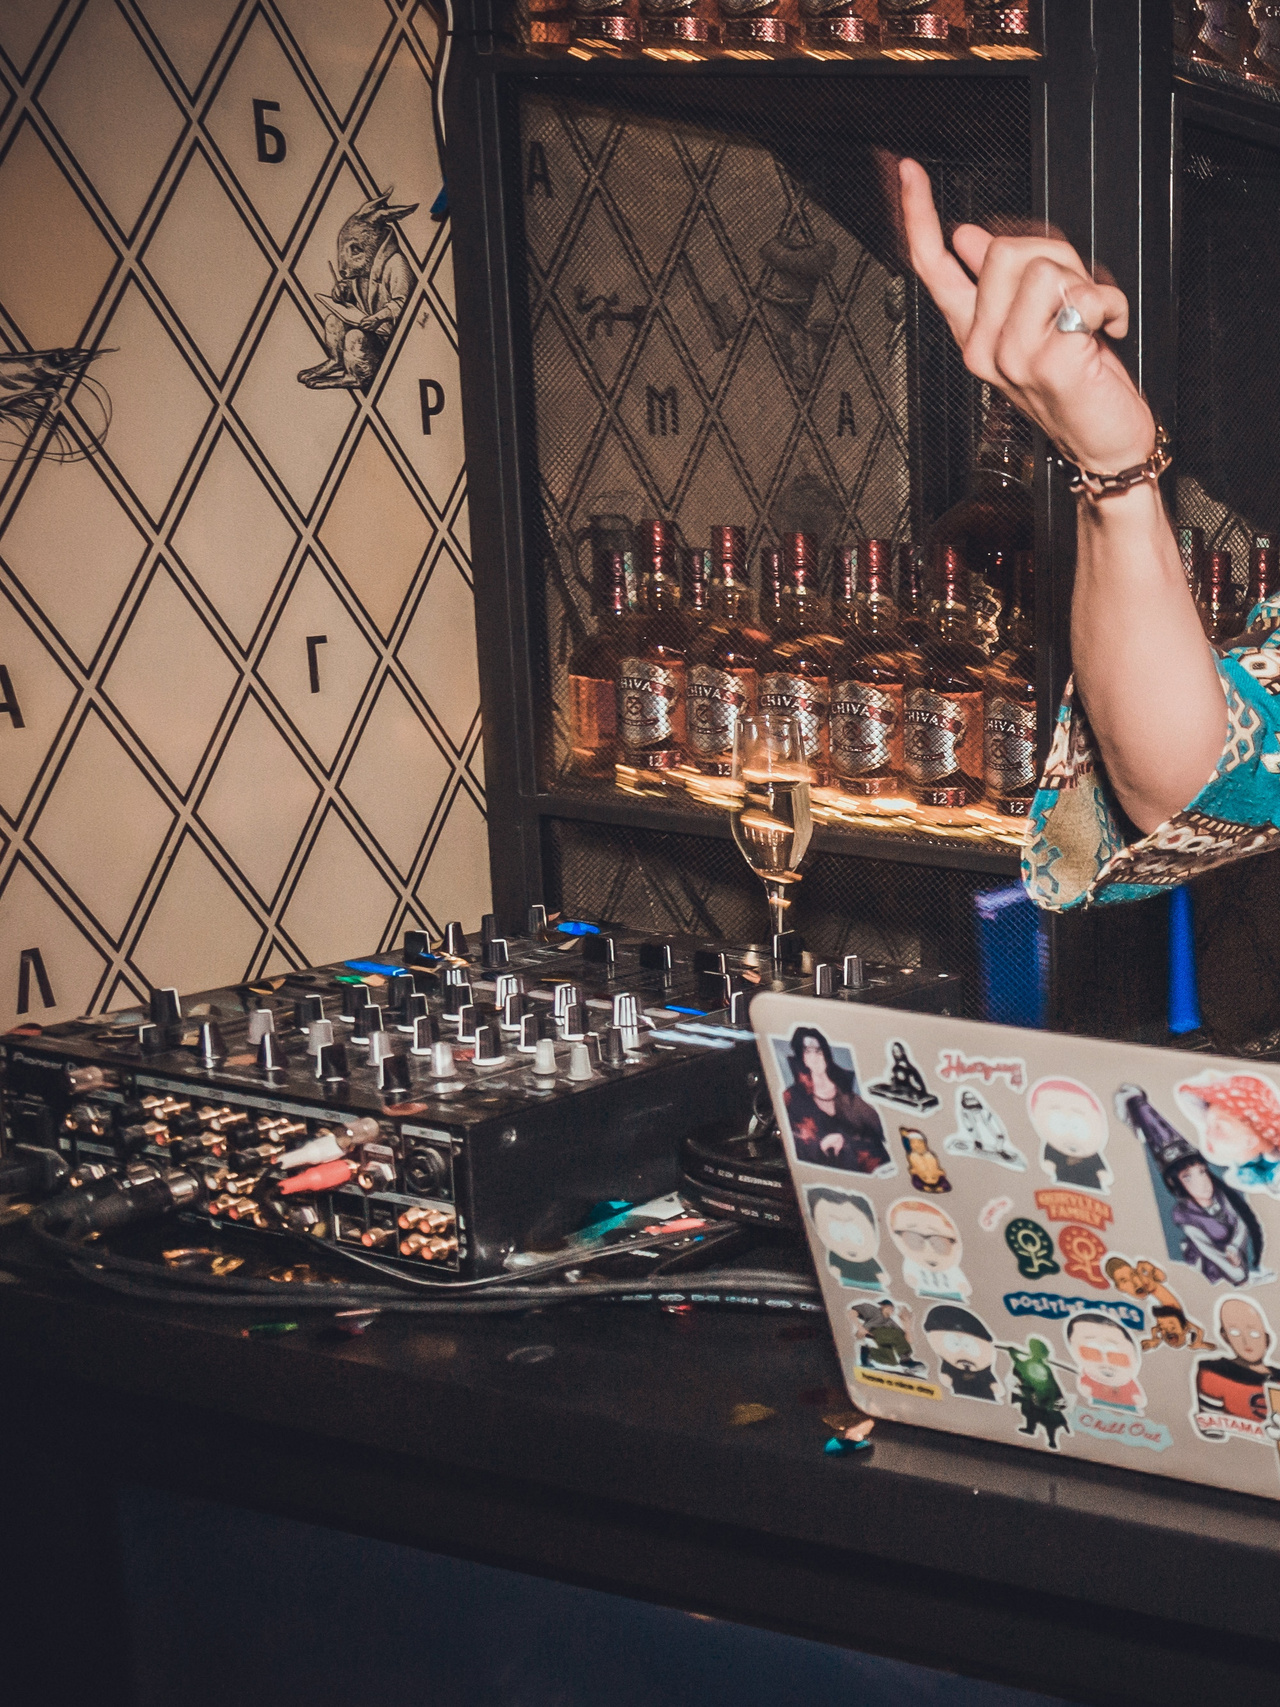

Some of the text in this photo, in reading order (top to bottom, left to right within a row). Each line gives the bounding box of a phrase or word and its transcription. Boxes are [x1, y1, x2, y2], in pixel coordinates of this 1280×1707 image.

[252, 98, 287, 164] Б
[419, 378, 446, 436] Р
[837, 392, 858, 438] А
[306, 635, 328, 693] Г
[619, 677, 665, 695] HIVAS
[717, 763, 731, 776] 12
[932, 791, 947, 806] 12
[1009, 801, 1025, 815] 12
[1197, 1415, 1265, 1437] SAITAMA
